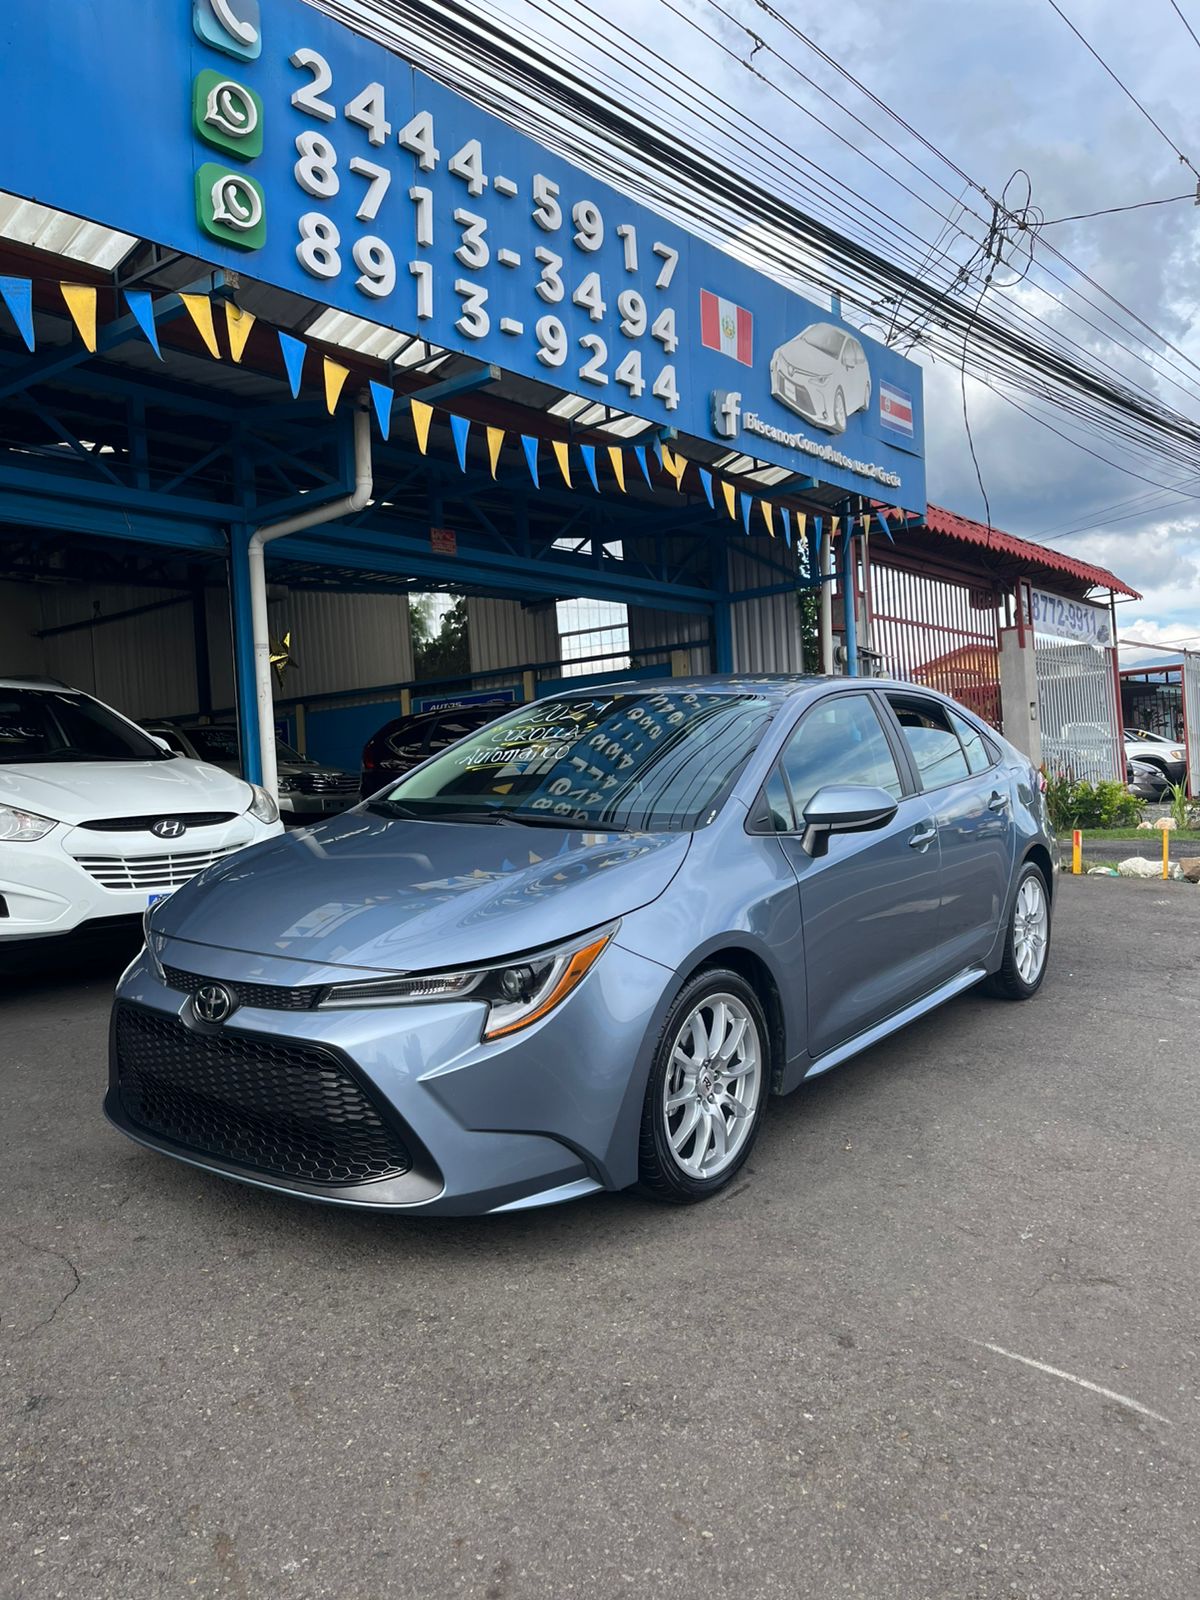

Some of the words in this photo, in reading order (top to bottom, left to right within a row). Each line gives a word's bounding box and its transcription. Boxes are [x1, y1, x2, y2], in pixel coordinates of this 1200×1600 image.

[288, 48, 679, 289] 2444-5917
[294, 130, 679, 354] 8713-3494
[296, 212, 680, 411] 8913-9244
[518, 700, 614, 725] 2021
